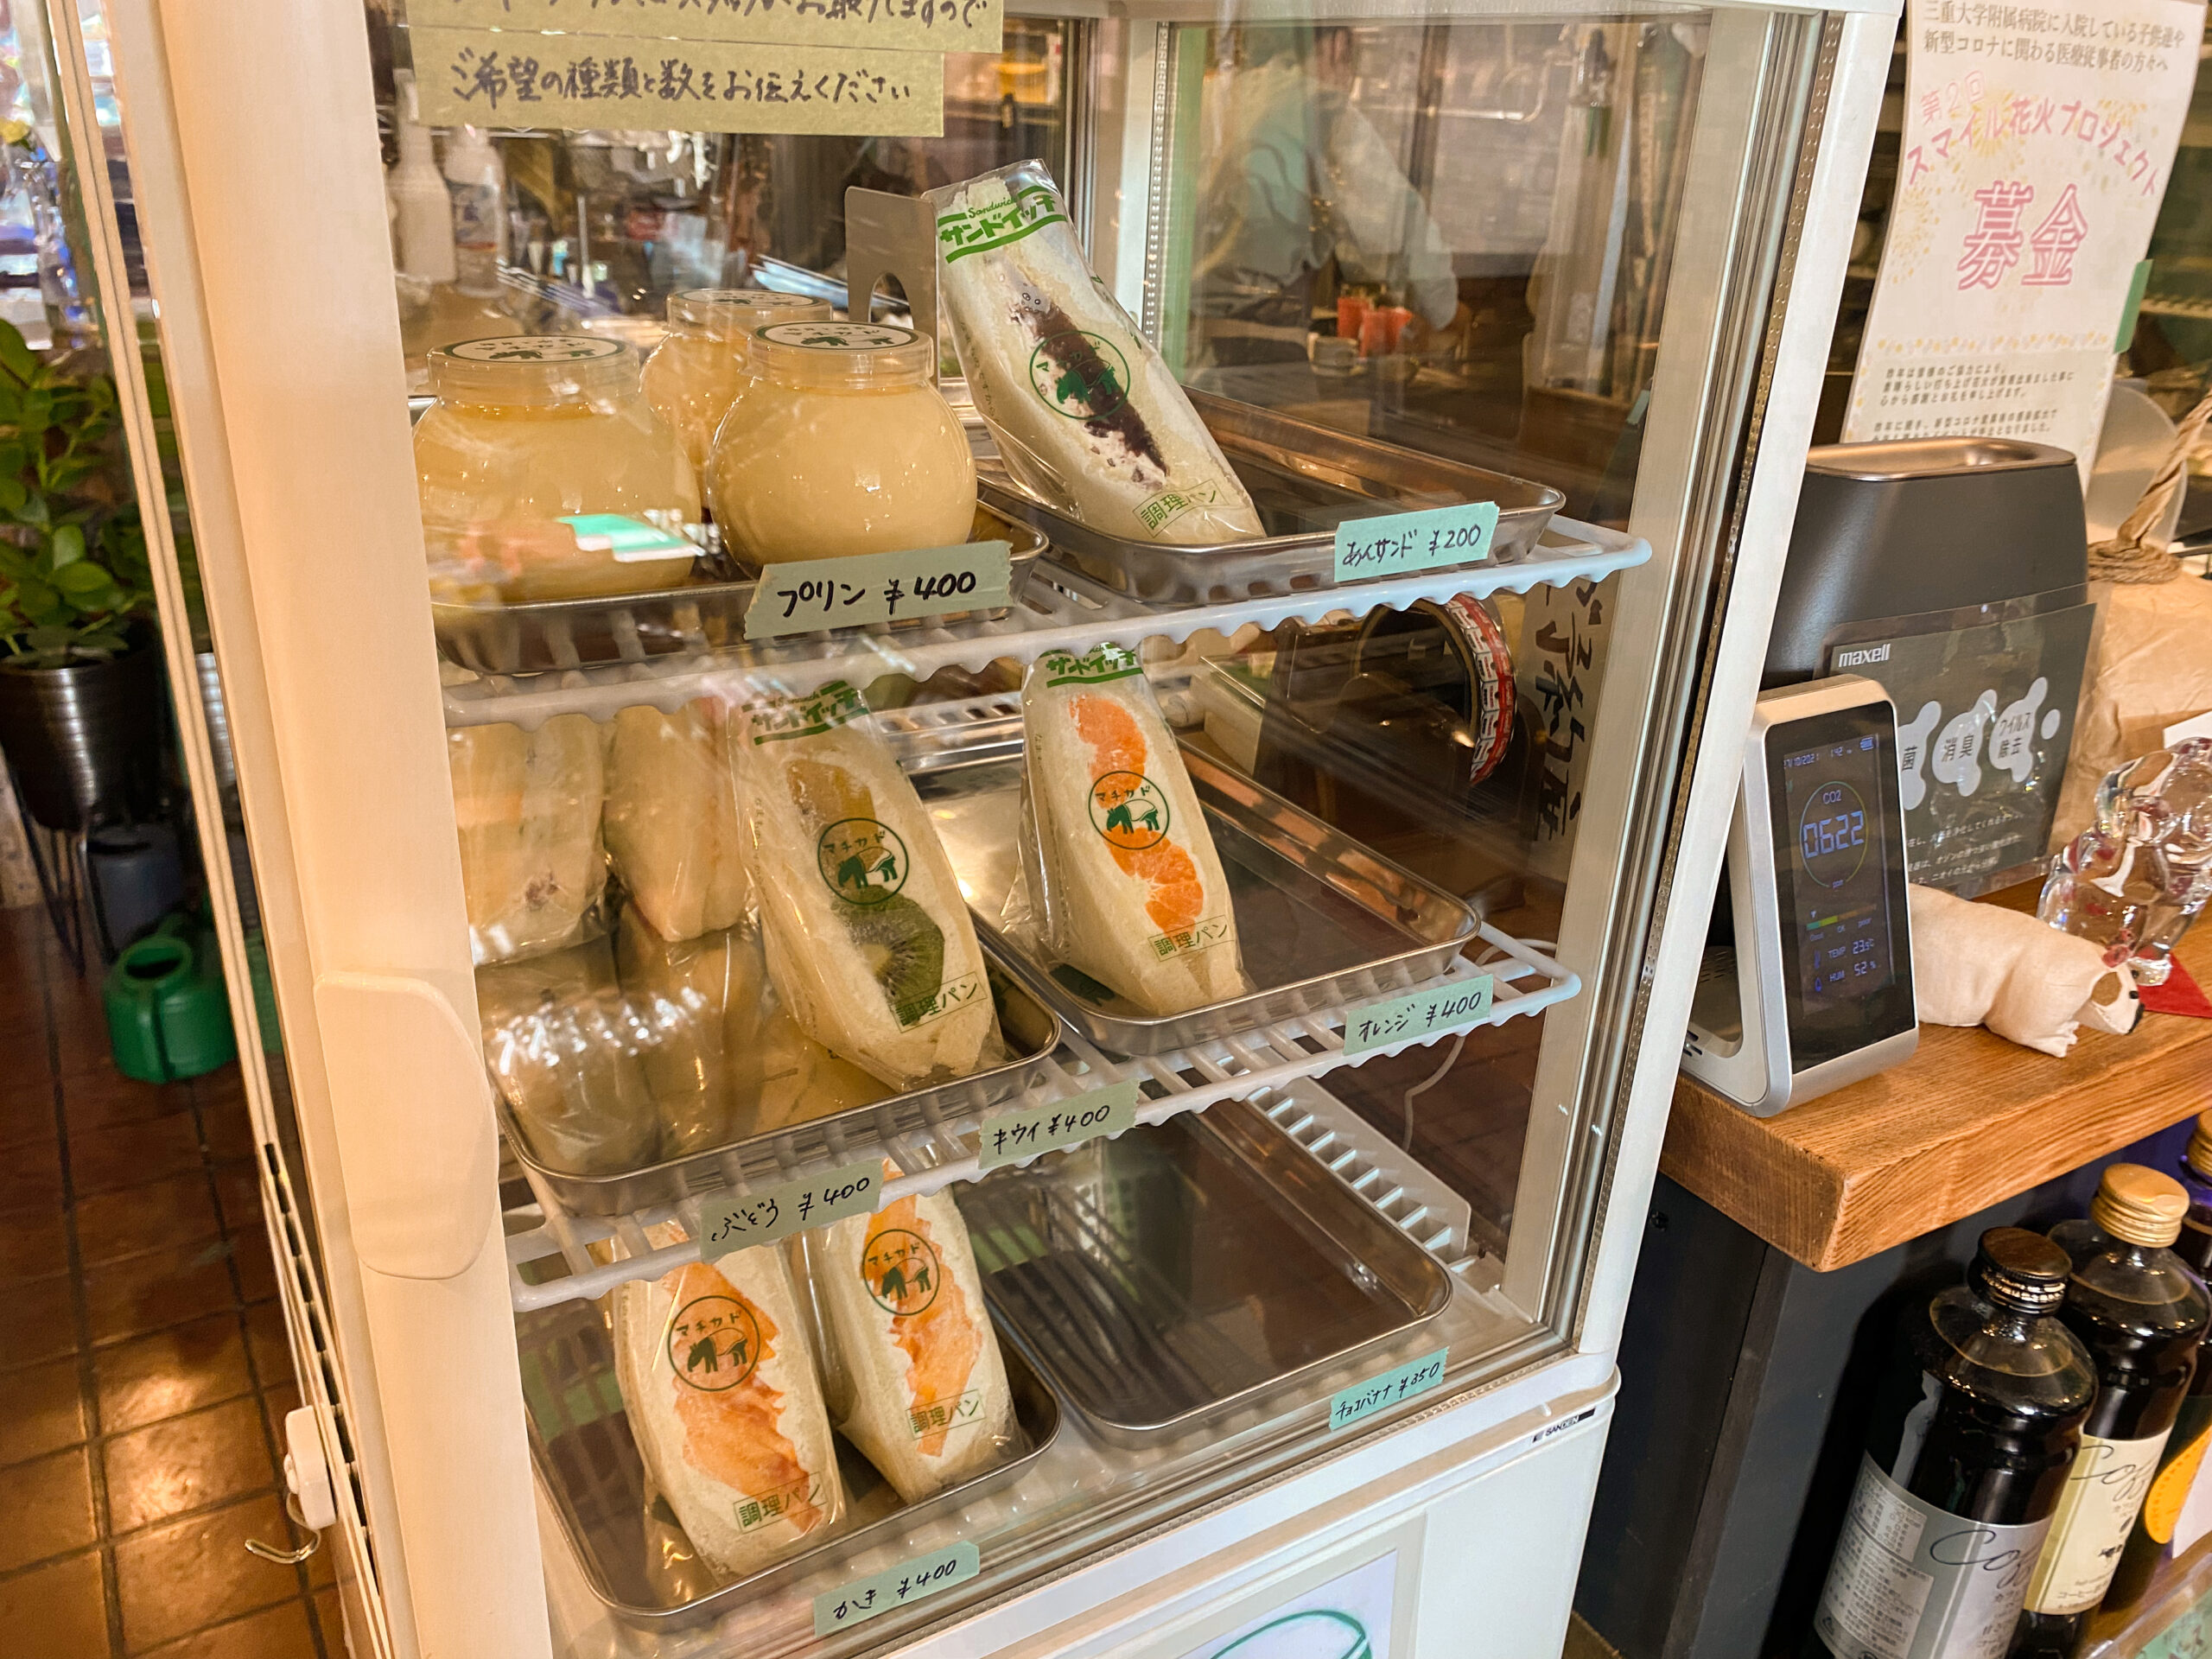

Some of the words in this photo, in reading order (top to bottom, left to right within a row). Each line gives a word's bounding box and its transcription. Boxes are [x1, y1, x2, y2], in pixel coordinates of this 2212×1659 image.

[451, 45, 911, 110] ご希望の種類と数をお伝えください
[939, 194, 1056, 246] サンドイッチ
[1956, 180, 2088, 290] 募金
[777, 579, 866, 618] プリン
[883, 570, 977, 616] ¥400
[1838, 643, 1891, 668] maxell
[1095, 784, 1152, 802] マチカド
[1822, 789, 1842, 804] CO2
[823, 830, 886, 854] マチカド
[1802, 810, 1865, 859] 0622
[1154, 921, 1229, 957] 調理パン
[894, 981, 979, 1027] 調理パン
[1357, 1002, 1416, 1043] オレンジ
[1426, 991, 1482, 1028] ¥400
[993, 1122, 1040, 1155] キウイ
[1047, 1104, 1110, 1136] ¥400
[710, 1198, 779, 1243] ぶどう
[868, 1241, 921, 1267] マチカド
[676, 1311, 743, 1338] マチカド
[911, 1398, 982, 1435] 調理パン
[1334, 1383, 1394, 1421] チョコバナナ
[737, 1481, 824, 1529] 調理パン
[832, 1588, 877, 1620] かき
[896, 1558, 957, 1599] ¥400
